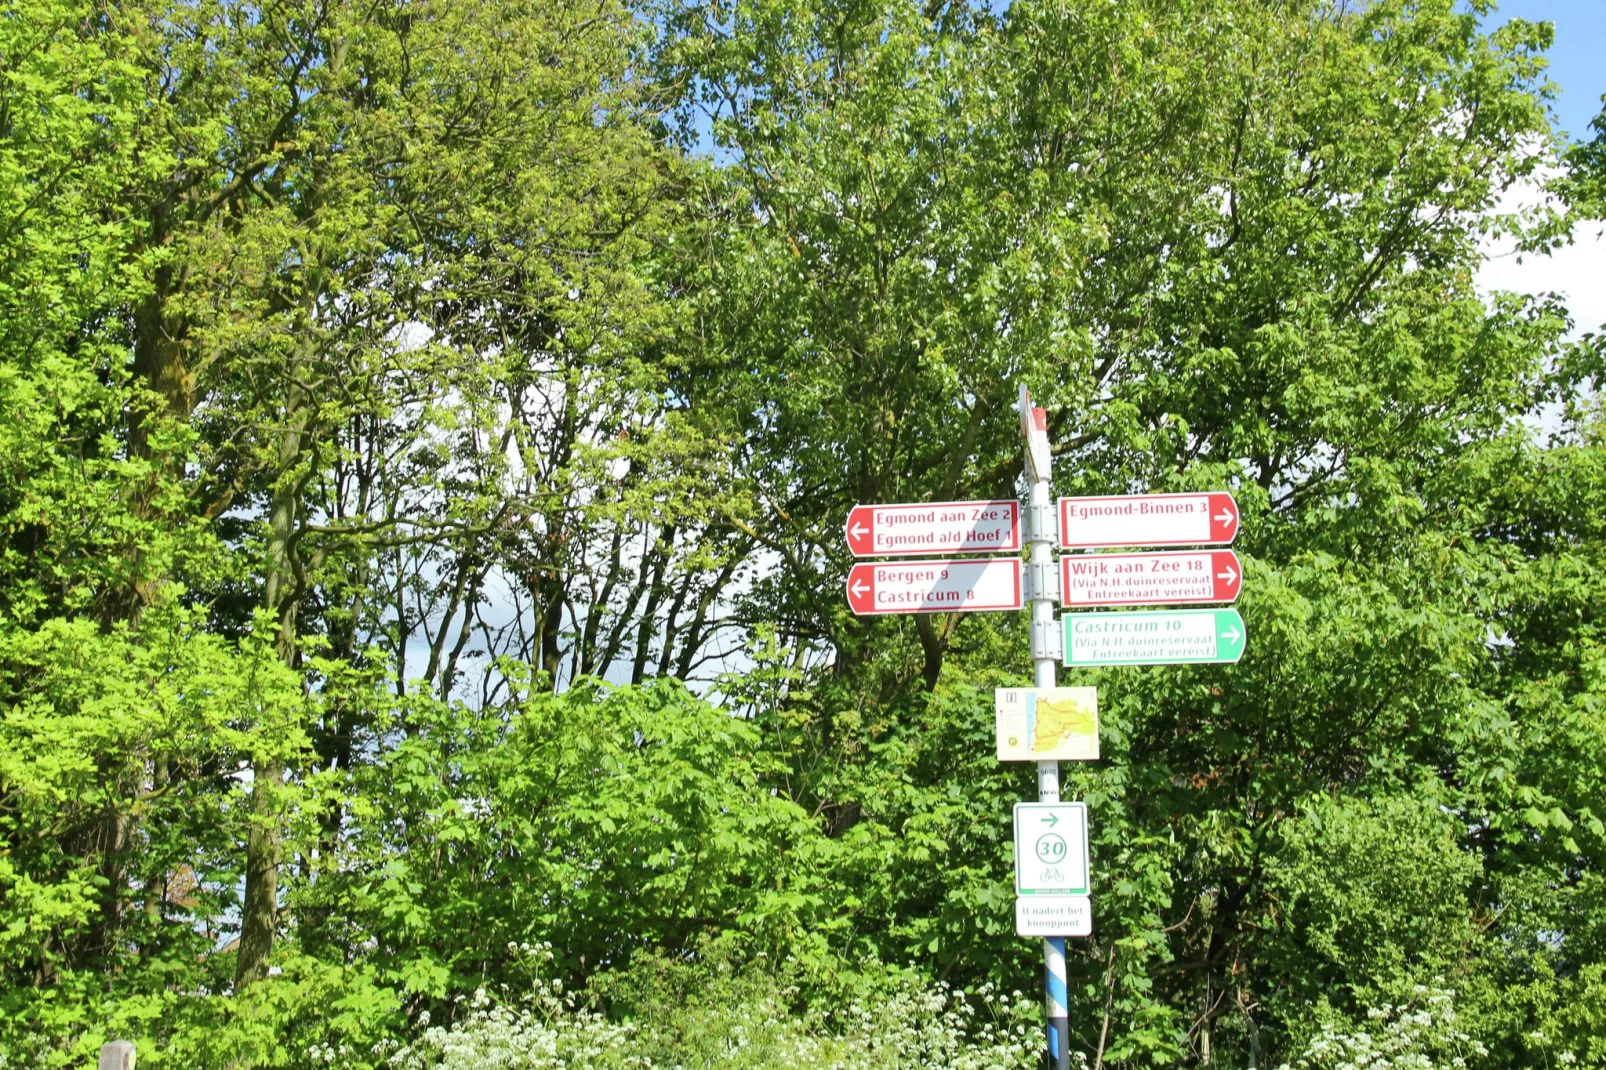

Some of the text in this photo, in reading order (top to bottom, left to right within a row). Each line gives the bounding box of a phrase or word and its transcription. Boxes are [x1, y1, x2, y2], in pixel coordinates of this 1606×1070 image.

[876, 508, 1010, 528] Egmond aan Zee 2
[1070, 502, 1208, 520] Egmond-Binnen 3
[876, 528, 1012, 548] Egmond a/d Hoef 1
[1072, 560, 1203, 578] Wijk aan Zee 18
[878, 570, 950, 584] Bergen 9
[1072, 578, 1096, 590] (Via
[878, 589, 975, 604] Castricum 8
[1088, 586, 1212, 600] Entreekaart vereist)
[1075, 620, 1182, 634] Castricum 10
[1092, 648, 1164, 659] Entreekaart
[1040, 842, 1064, 856] 30
[1032, 907, 1064, 915] nadert
[1068, 907, 1083, 915] het
[1028, 920, 1079, 928] knooppunt
